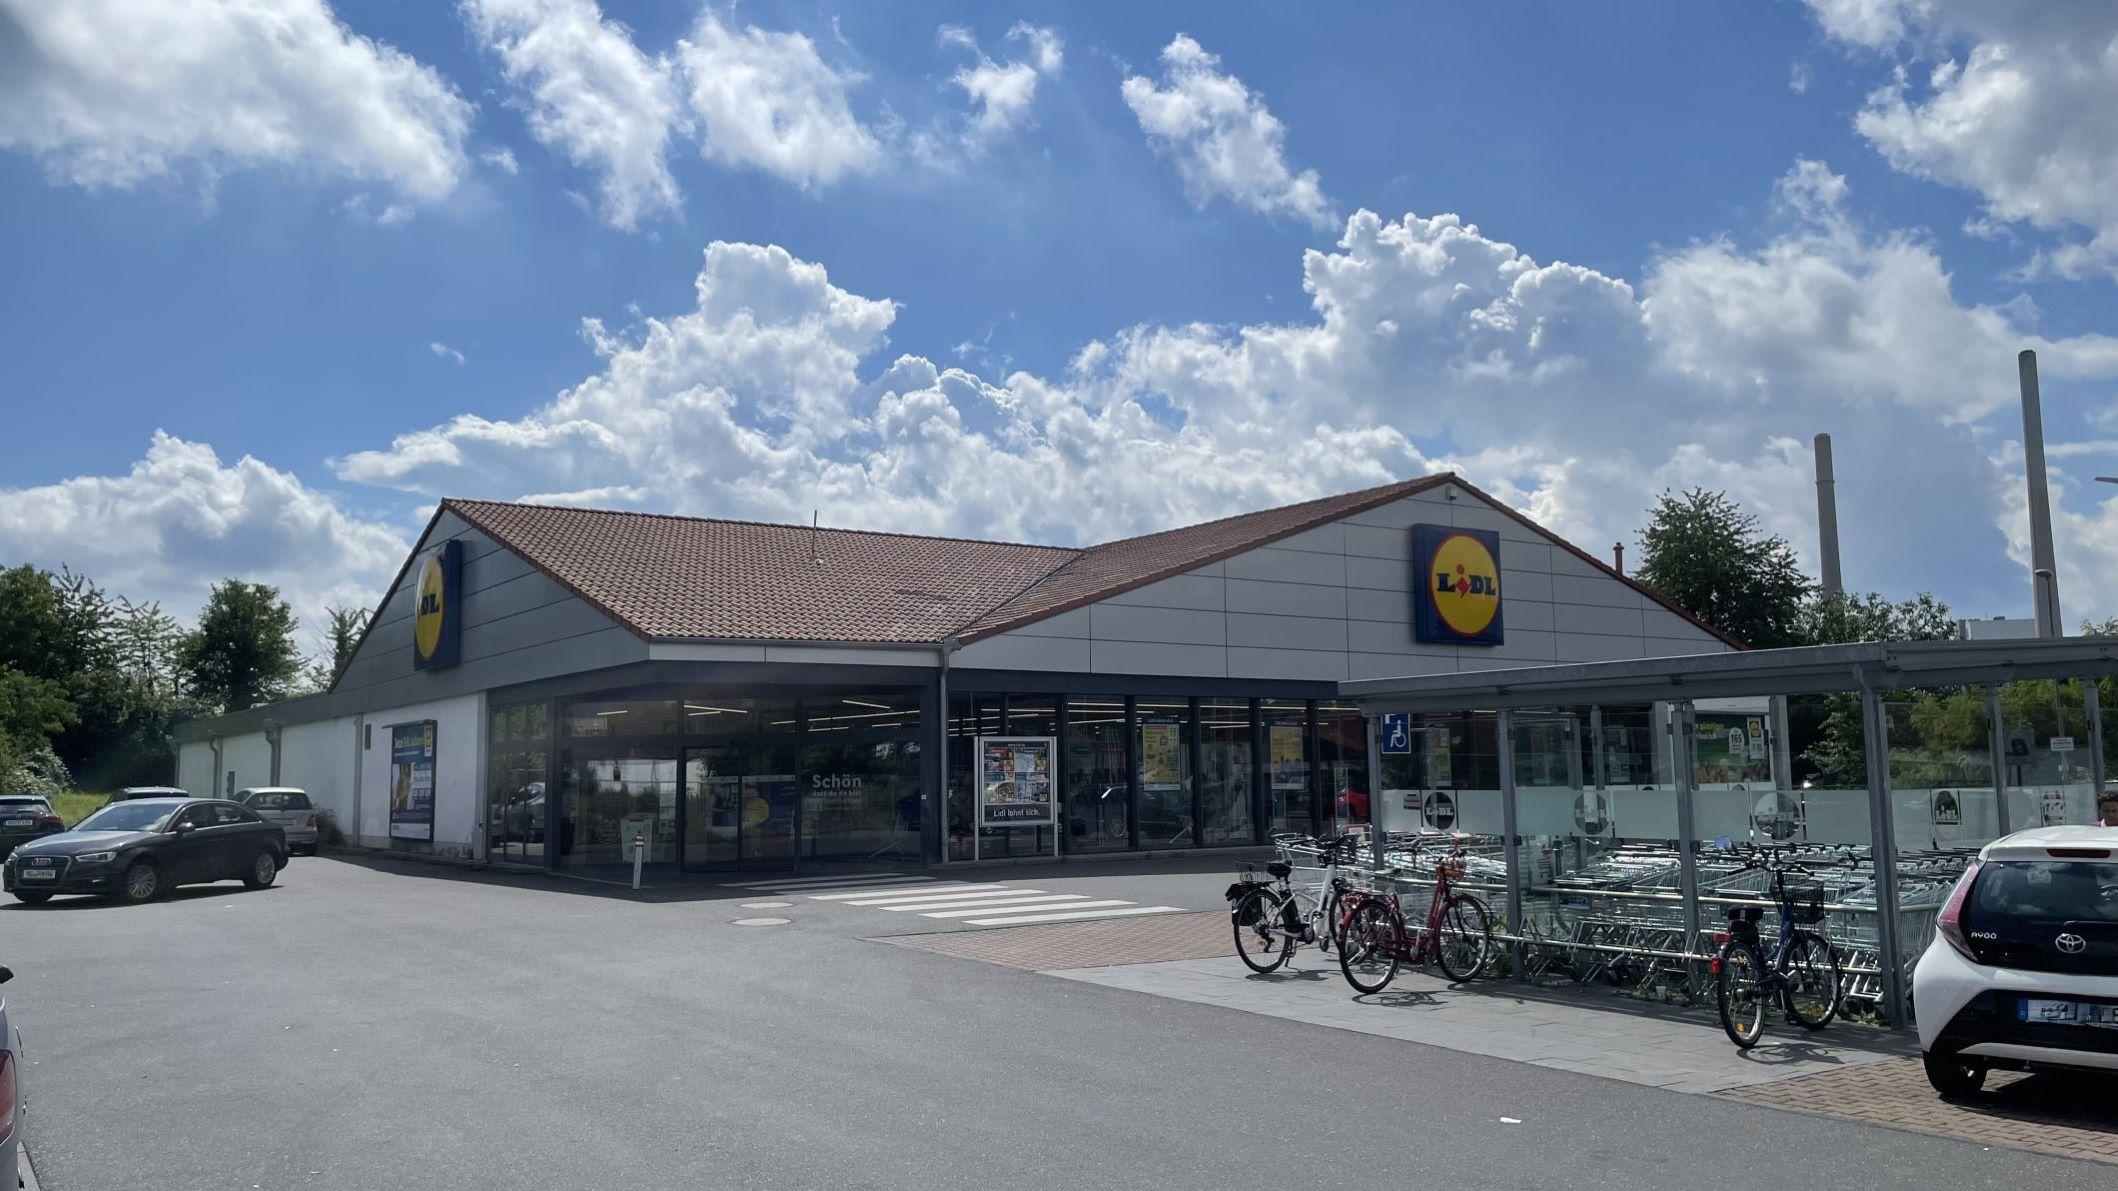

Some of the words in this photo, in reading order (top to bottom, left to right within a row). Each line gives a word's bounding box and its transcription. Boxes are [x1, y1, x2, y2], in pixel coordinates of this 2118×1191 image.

[1436, 564, 1497, 599] LIDL
[811, 773, 862, 788] Schön
[993, 808, 1006, 817] Lidl
[1007, 808, 1024, 817] lohnt
